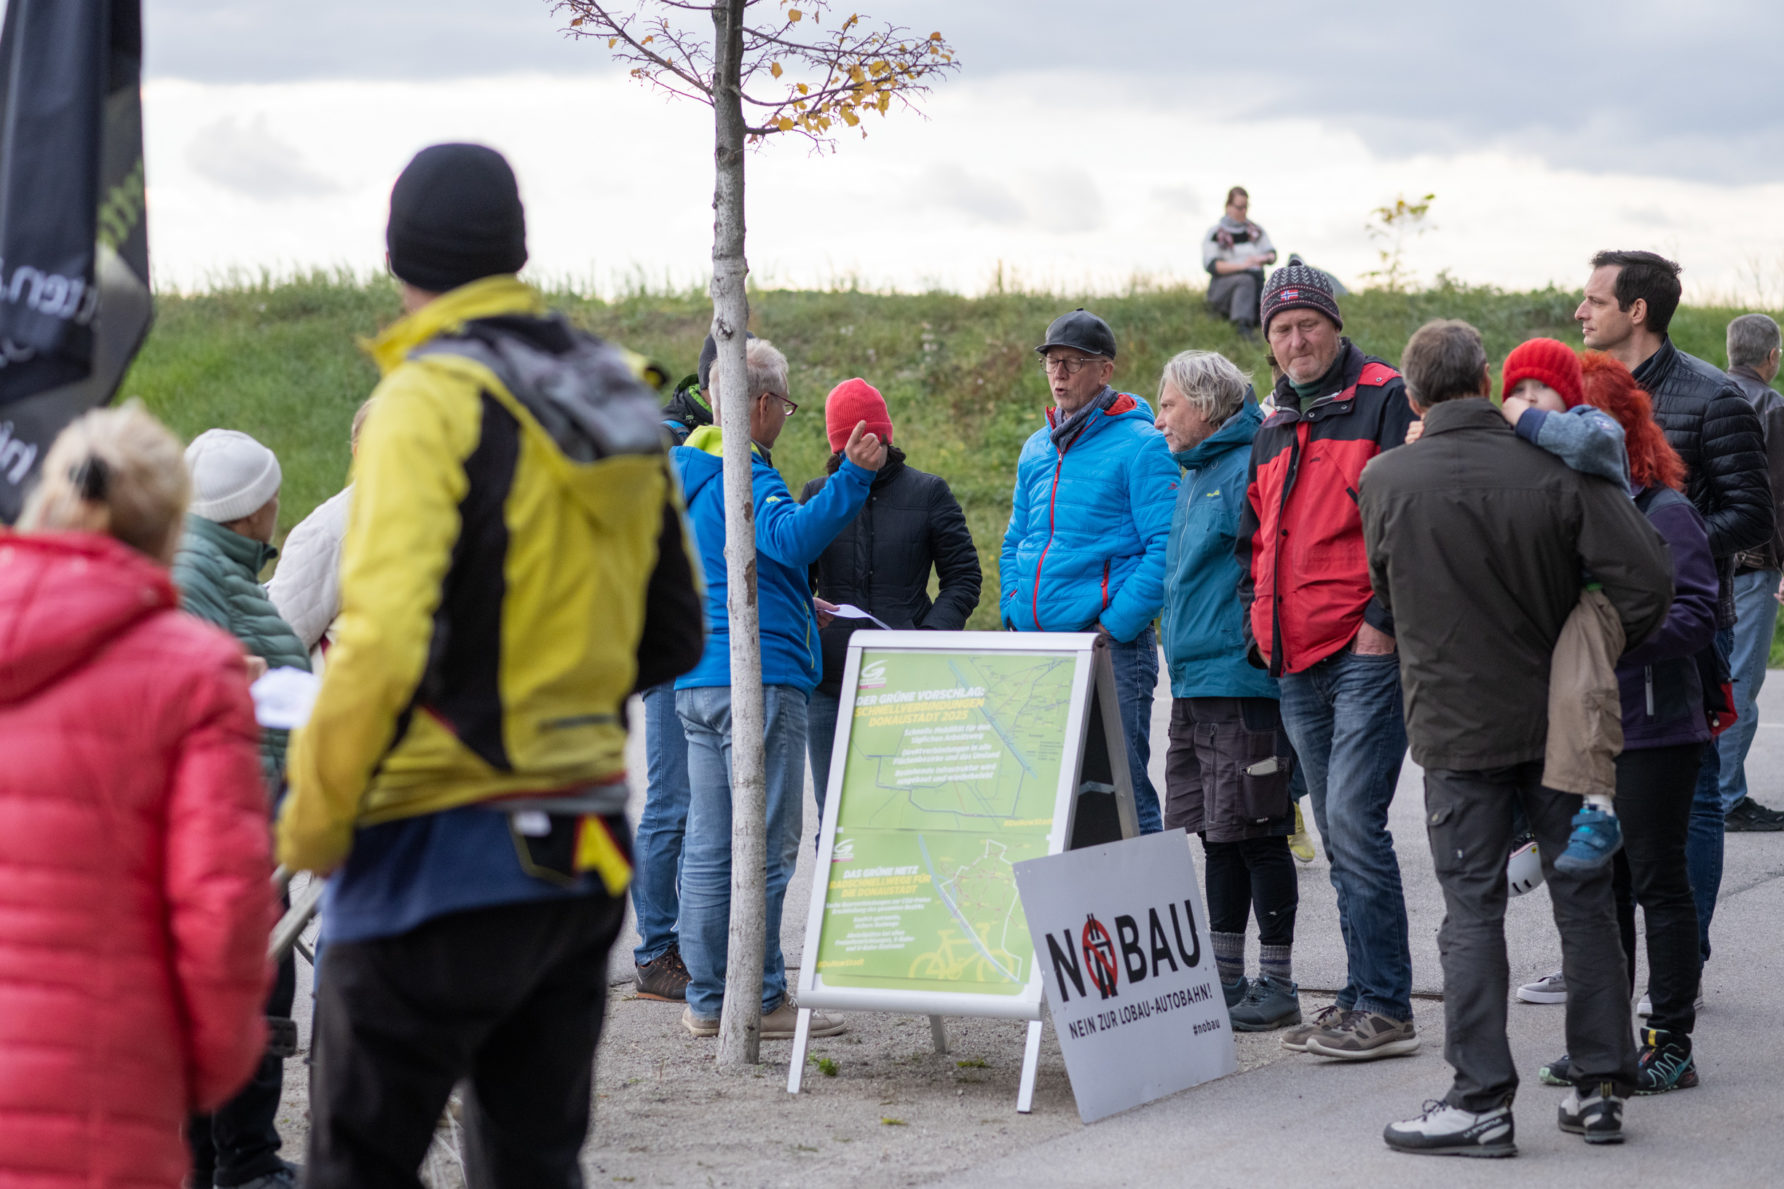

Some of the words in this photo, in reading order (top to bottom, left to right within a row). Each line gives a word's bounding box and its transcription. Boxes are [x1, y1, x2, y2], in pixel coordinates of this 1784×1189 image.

[856, 695, 878, 706] DER
[880, 690, 917, 704] GRÜNE
[917, 686, 986, 701] VORSCHLAG:
[1068, 1016, 1097, 1040] NEIN
[1097, 1010, 1118, 1031] ZUR
[1118, 982, 1213, 1025] LOBAU-AUTOBAHN!
[1193, 1019, 1220, 1036] #nobau
